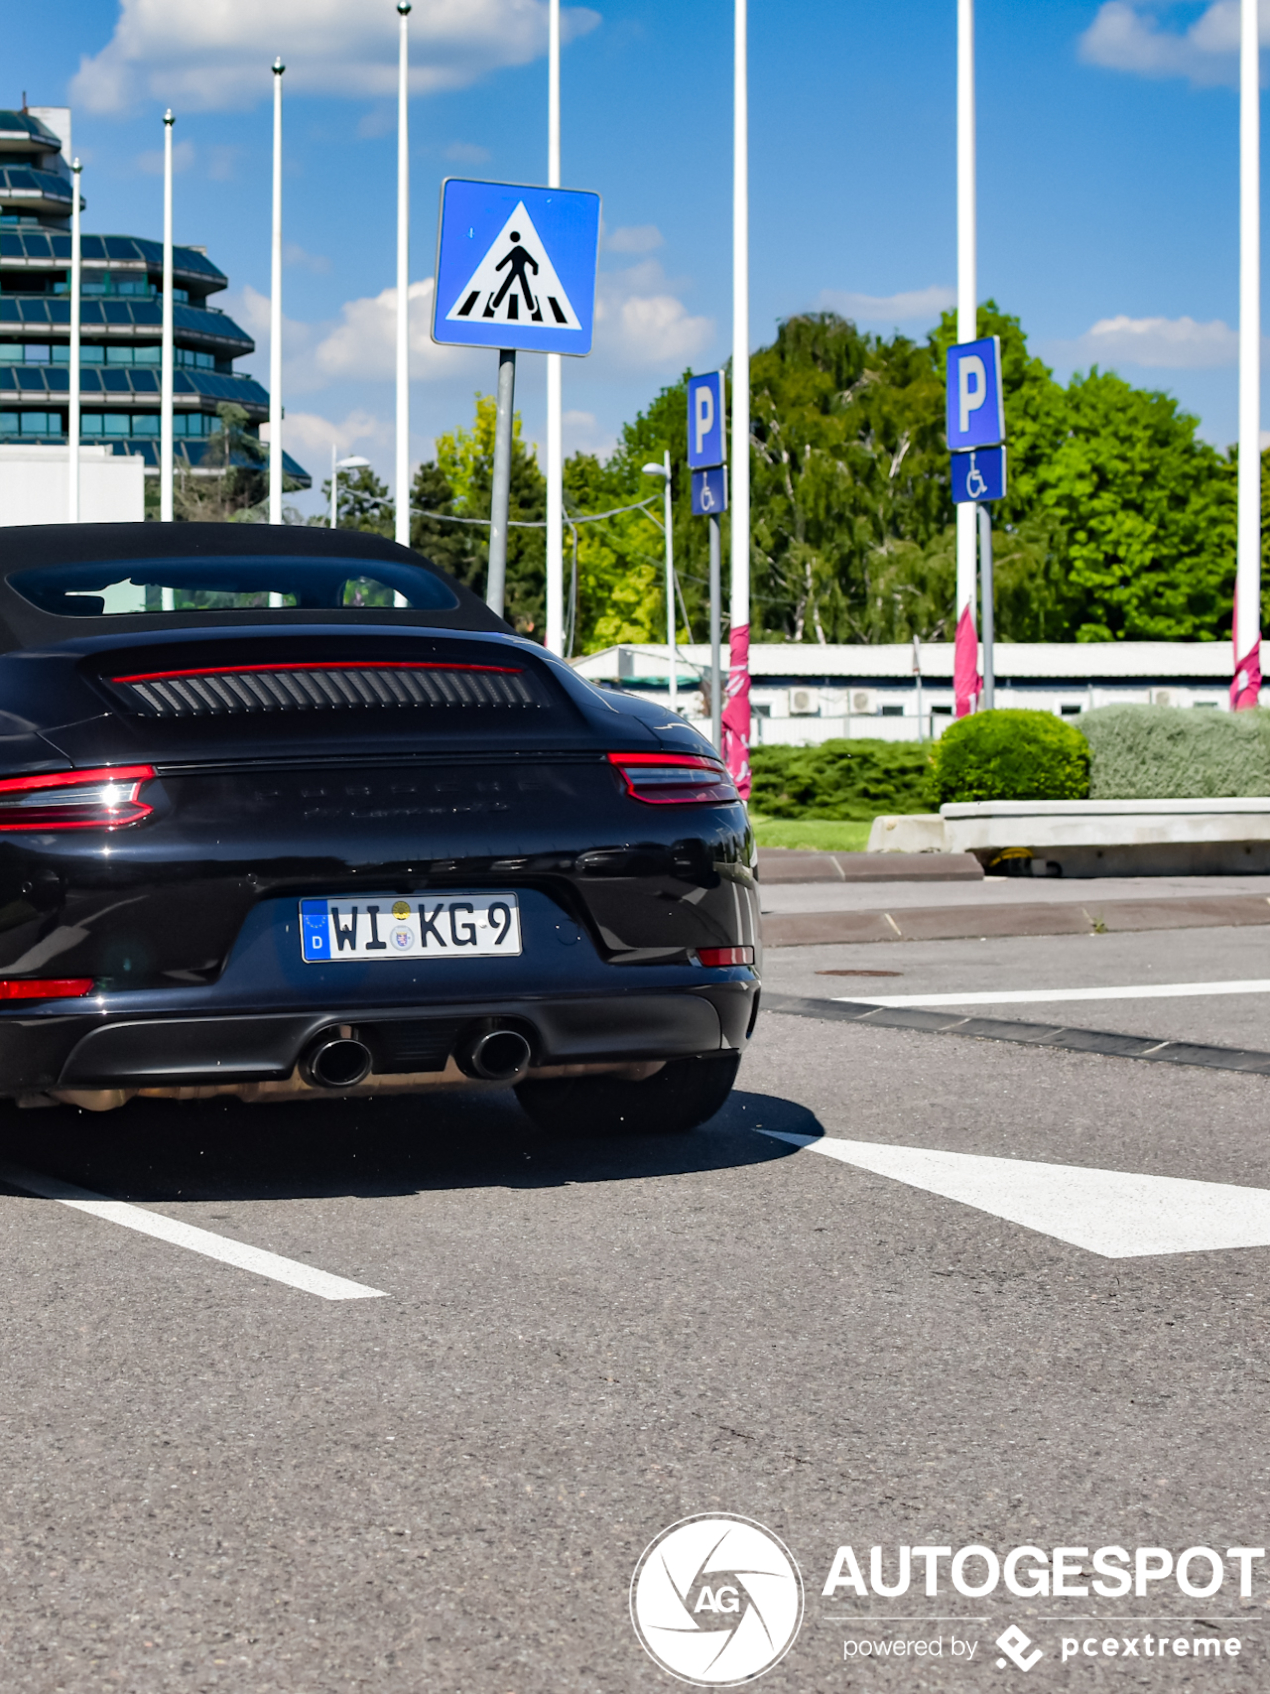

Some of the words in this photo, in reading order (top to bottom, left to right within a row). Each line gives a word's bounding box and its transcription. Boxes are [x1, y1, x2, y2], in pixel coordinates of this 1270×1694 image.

[695, 386, 714, 454] P
[958, 355, 987, 433] P
[312, 936, 323, 949] D
[331, 906, 387, 951] WI
